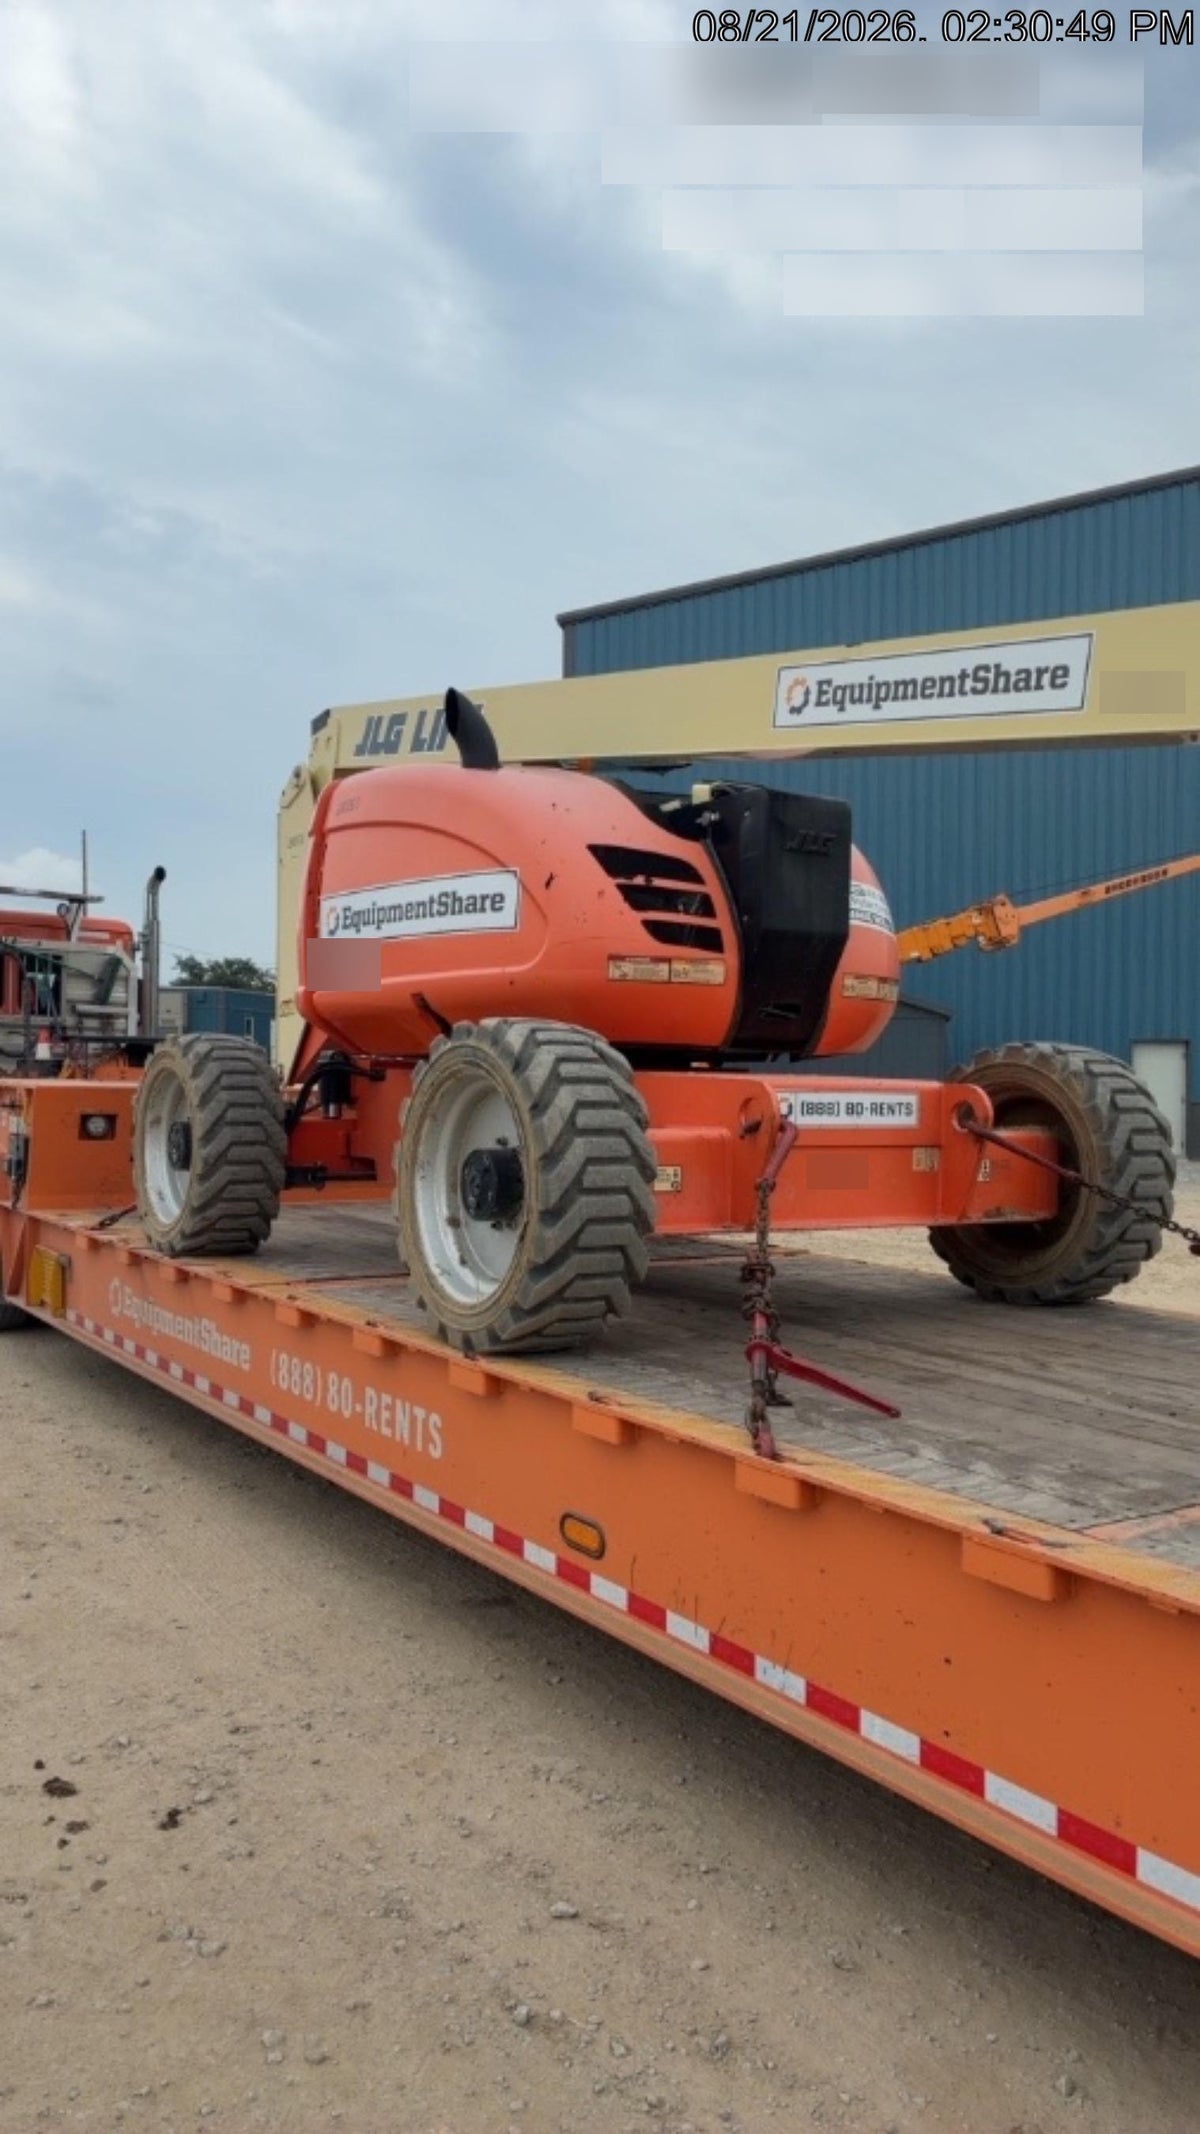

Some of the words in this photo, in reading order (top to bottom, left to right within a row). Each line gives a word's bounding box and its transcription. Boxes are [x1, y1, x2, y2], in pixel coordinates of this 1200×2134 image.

[814, 663, 1070, 712] EquipmentShare
[353, 711, 408, 756] JLG
[341, 890, 505, 933] EquipmentShare
[122, 1284, 250, 1372] EquipmentShare
[271, 1348, 321, 1406] (888)
[327, 1371, 443, 1459] 80-RENTS
